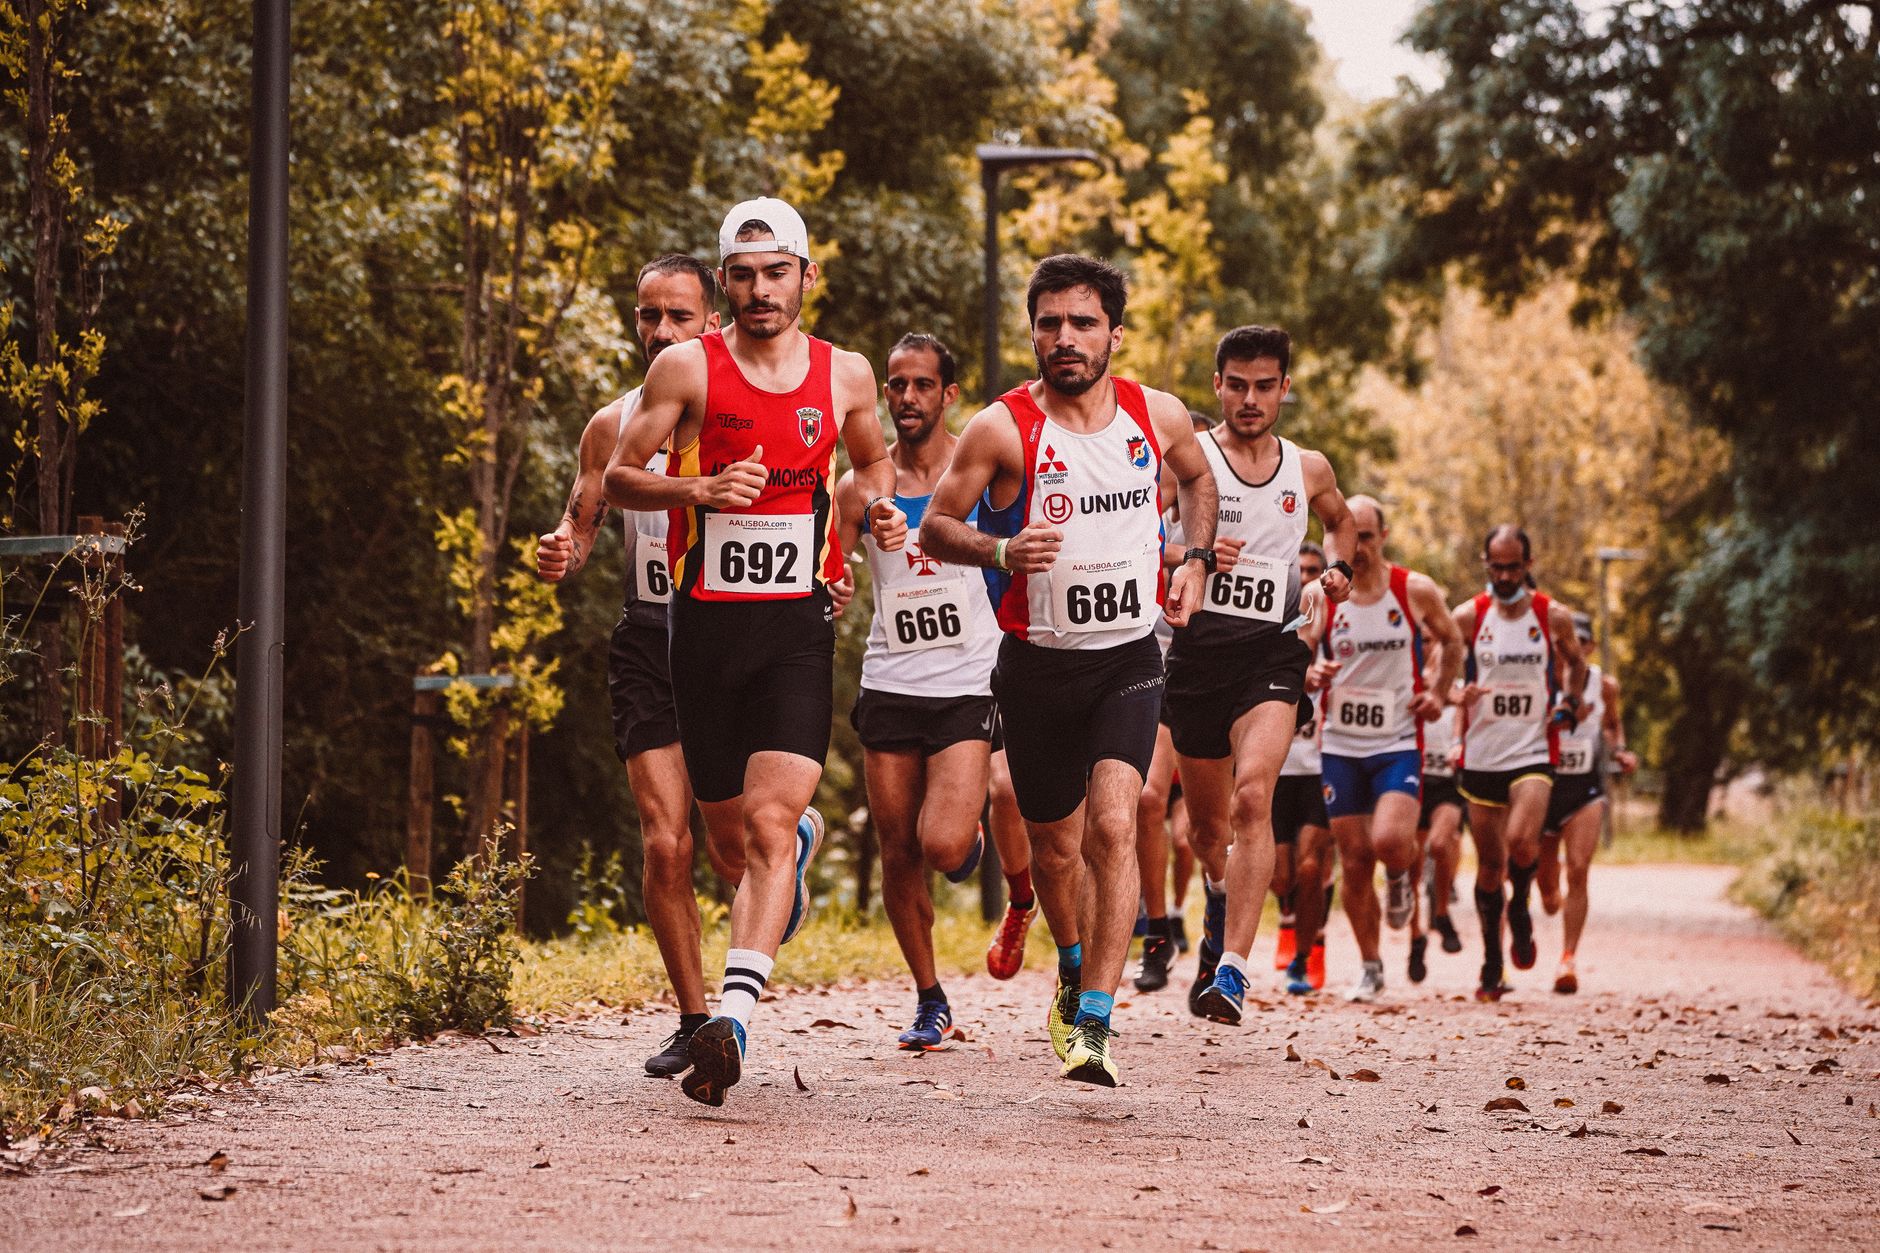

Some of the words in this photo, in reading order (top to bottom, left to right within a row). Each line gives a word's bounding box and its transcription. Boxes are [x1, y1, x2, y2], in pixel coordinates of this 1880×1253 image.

[1038, 472, 1069, 480] MITSUBISHI
[1080, 486, 1152, 515] UNIVEX
[728, 519, 787, 528] AALISBOA.com
[720, 540, 799, 585] 692
[1072, 560, 1127, 571] AALISBOA.com
[897, 587, 943, 598] AALISBOA.com
[1066, 578, 1142, 625] 684
[1210, 572, 1275, 613] 658
[895, 603, 961, 645] 666
[1340, 702, 1385, 728] 686
[1493, 694, 1533, 717] 687
